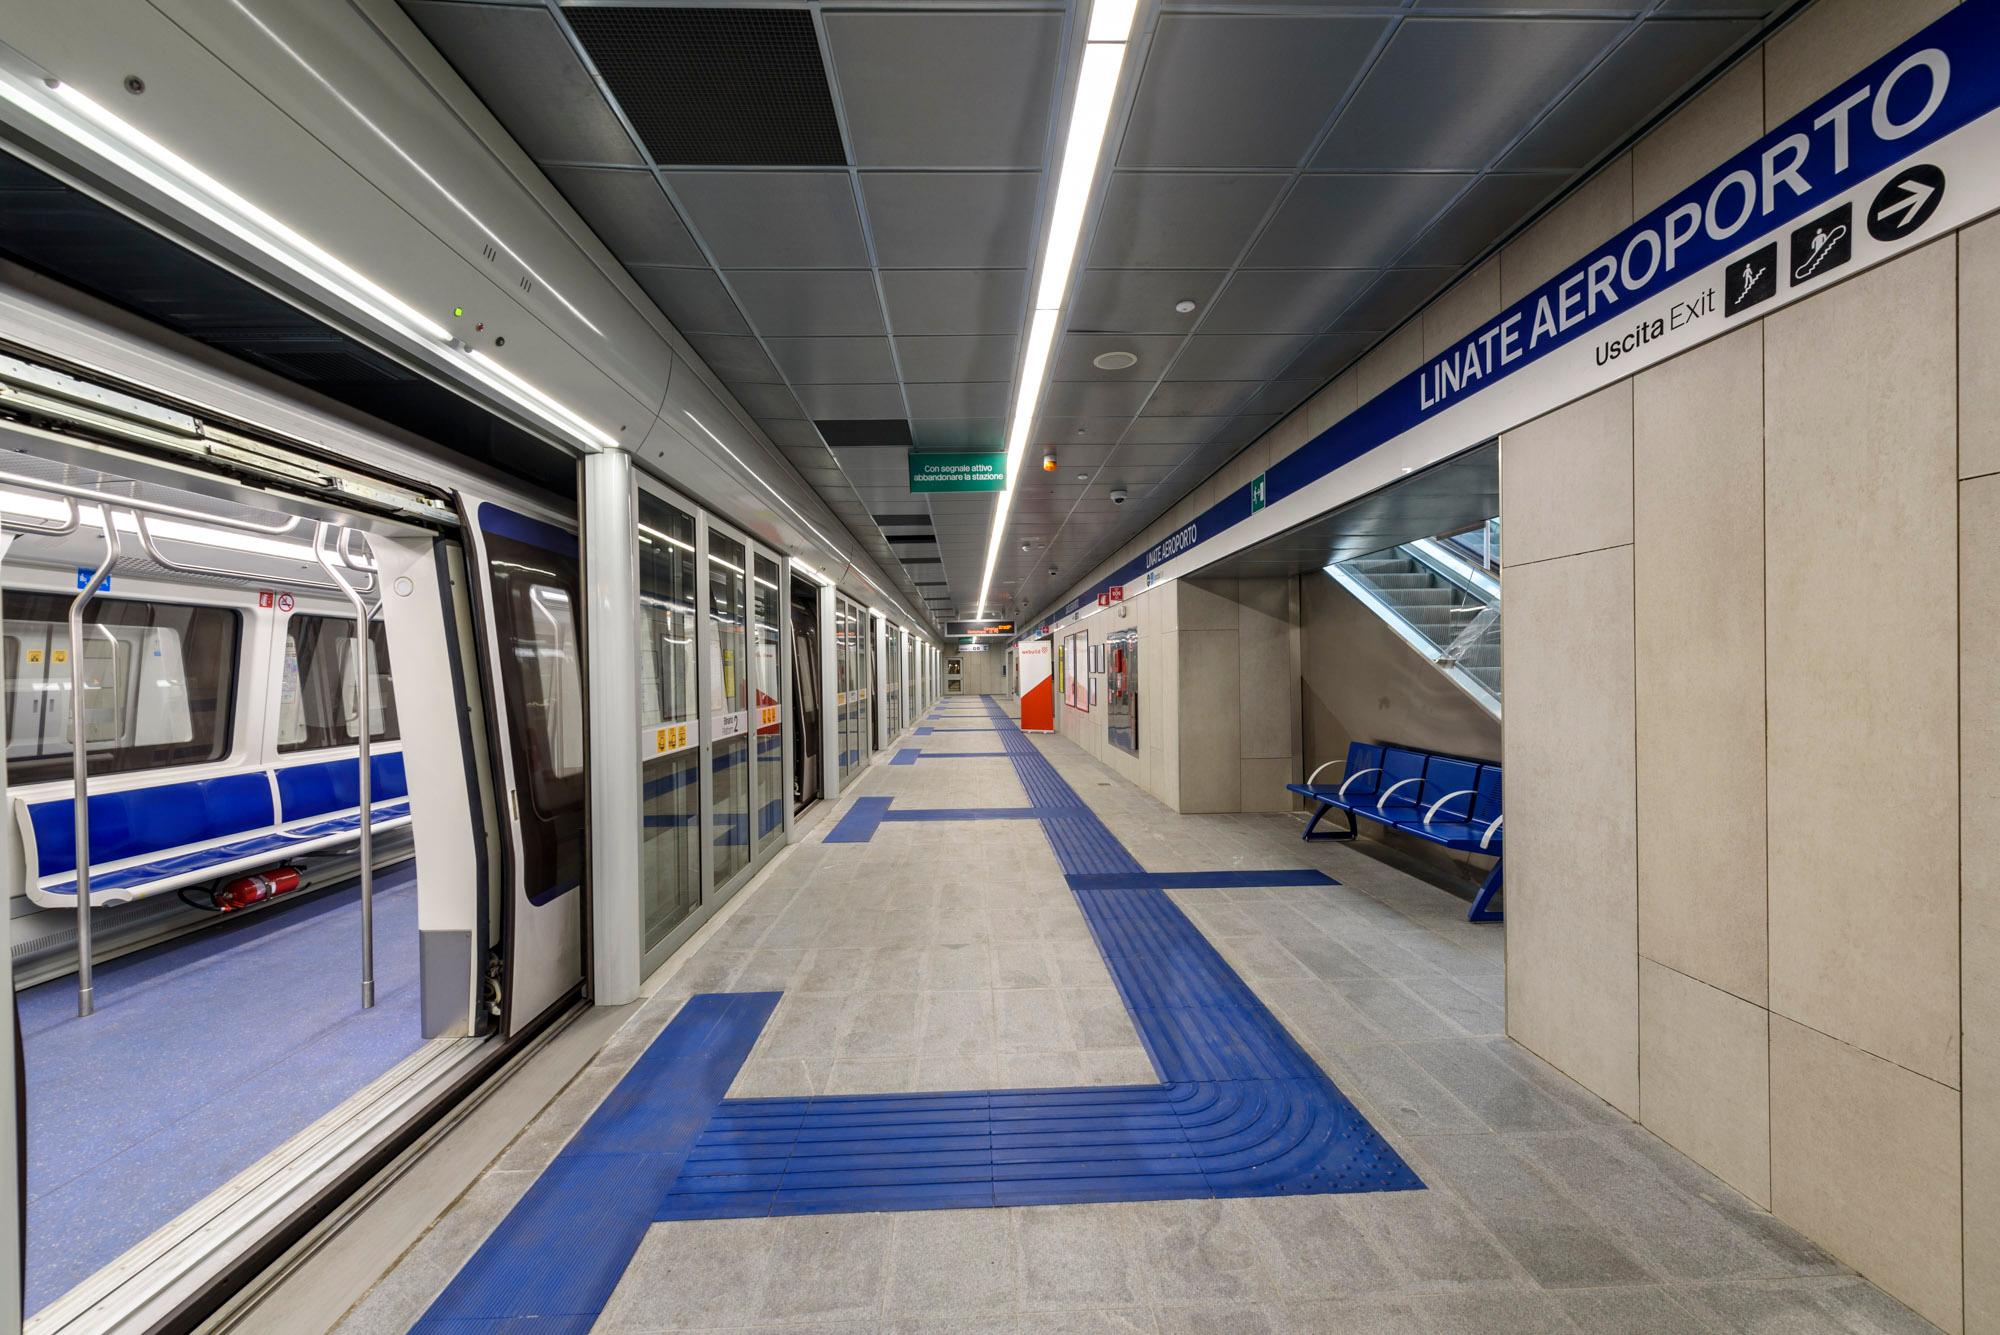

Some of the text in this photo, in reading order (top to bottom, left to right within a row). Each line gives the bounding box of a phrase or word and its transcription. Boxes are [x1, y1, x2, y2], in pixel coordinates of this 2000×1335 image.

[1420, 48, 1950, 411] LINATE AEROPORTO
[1595, 288, 1715, 366] Uscita Exit
[914, 473, 964, 482] abbandonare
[964, 473, 971, 481] la
[924, 464, 993, 474] Con segnale attivo
[1146, 524, 1197, 569] LINATE AEROPORTO
[733, 714, 739, 733] 2
